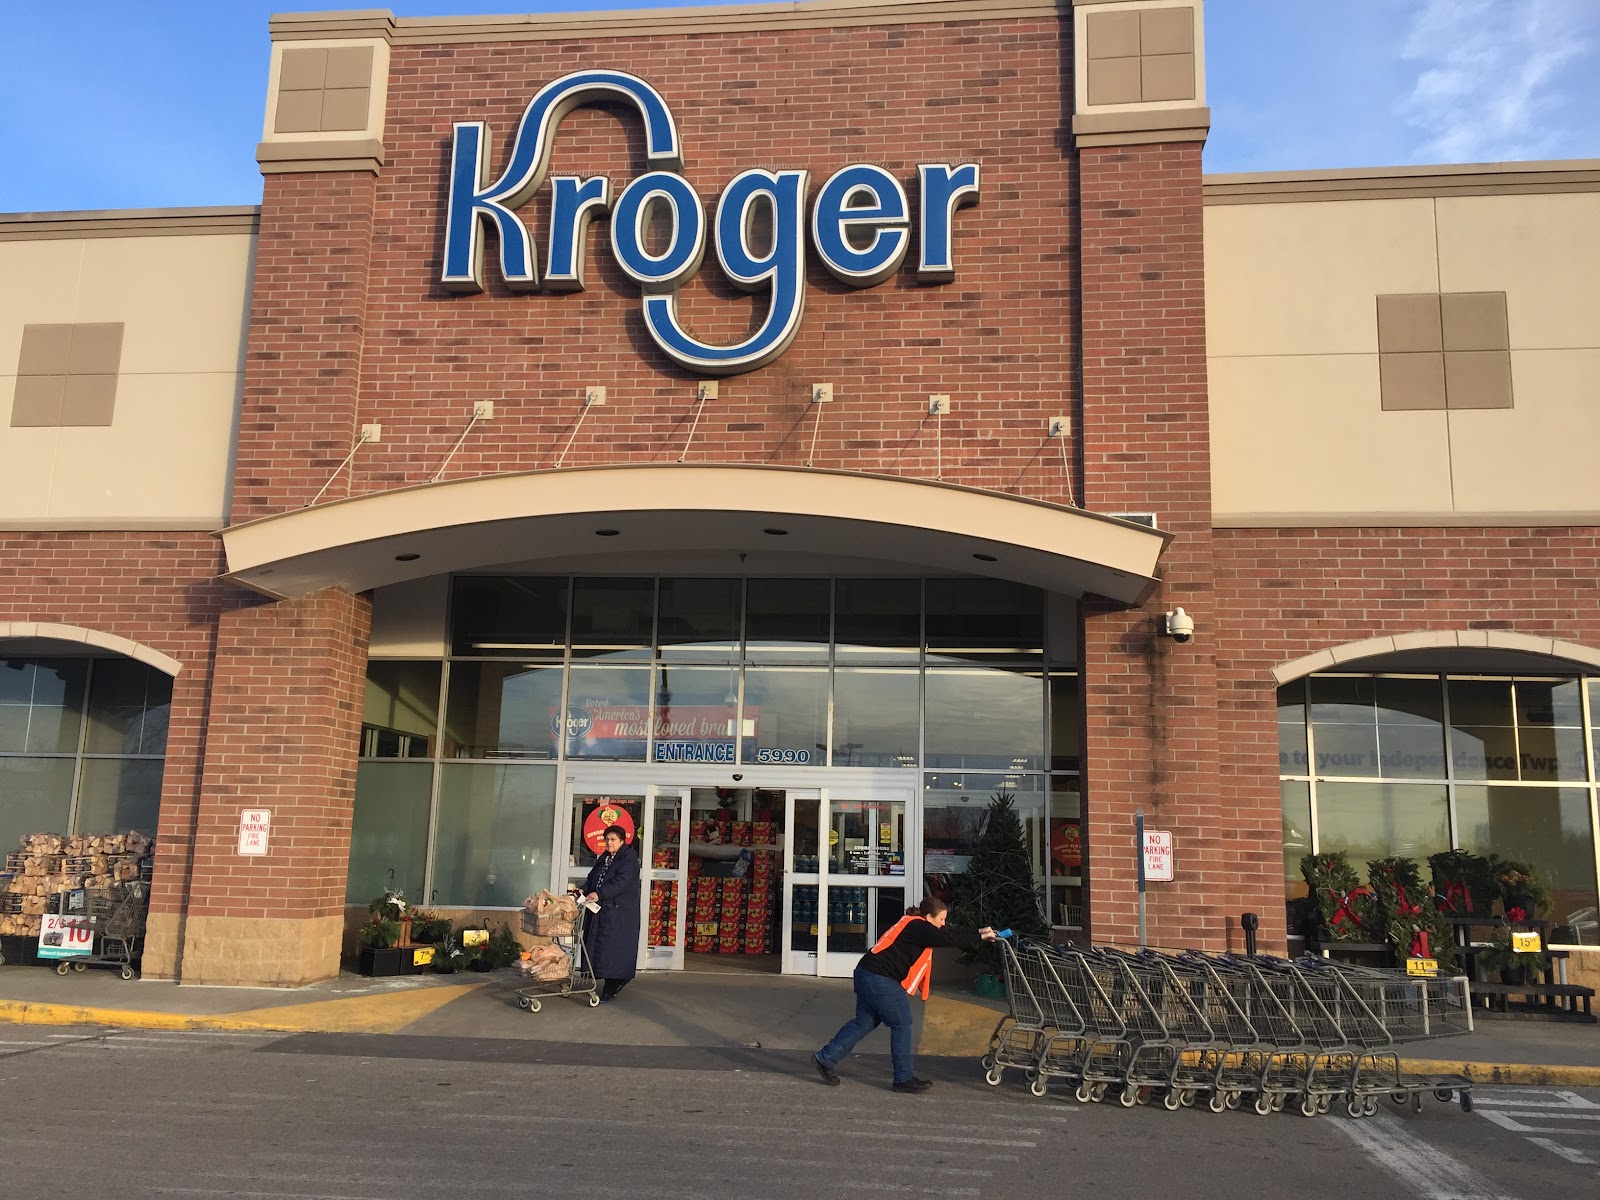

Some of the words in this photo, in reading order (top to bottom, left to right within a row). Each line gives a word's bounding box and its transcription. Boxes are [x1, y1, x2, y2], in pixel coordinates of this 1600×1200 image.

[440, 69, 980, 373] Kroger
[585, 698, 609, 708] Voted
[555, 709, 589, 736] Koger
[614, 719, 650, 736] most
[654, 717, 696, 736] loved
[656, 743, 735, 763] ENTRANCE
[757, 748, 810, 764] 5990
[1318, 751, 1364, 768] your
[1370, 750, 1515, 771] Indepedence
[250, 814, 261, 822] NO
[242, 823, 267, 832] PARKING
[1149, 835, 1161, 844] NO
[1149, 855, 1162, 863] FIRE
